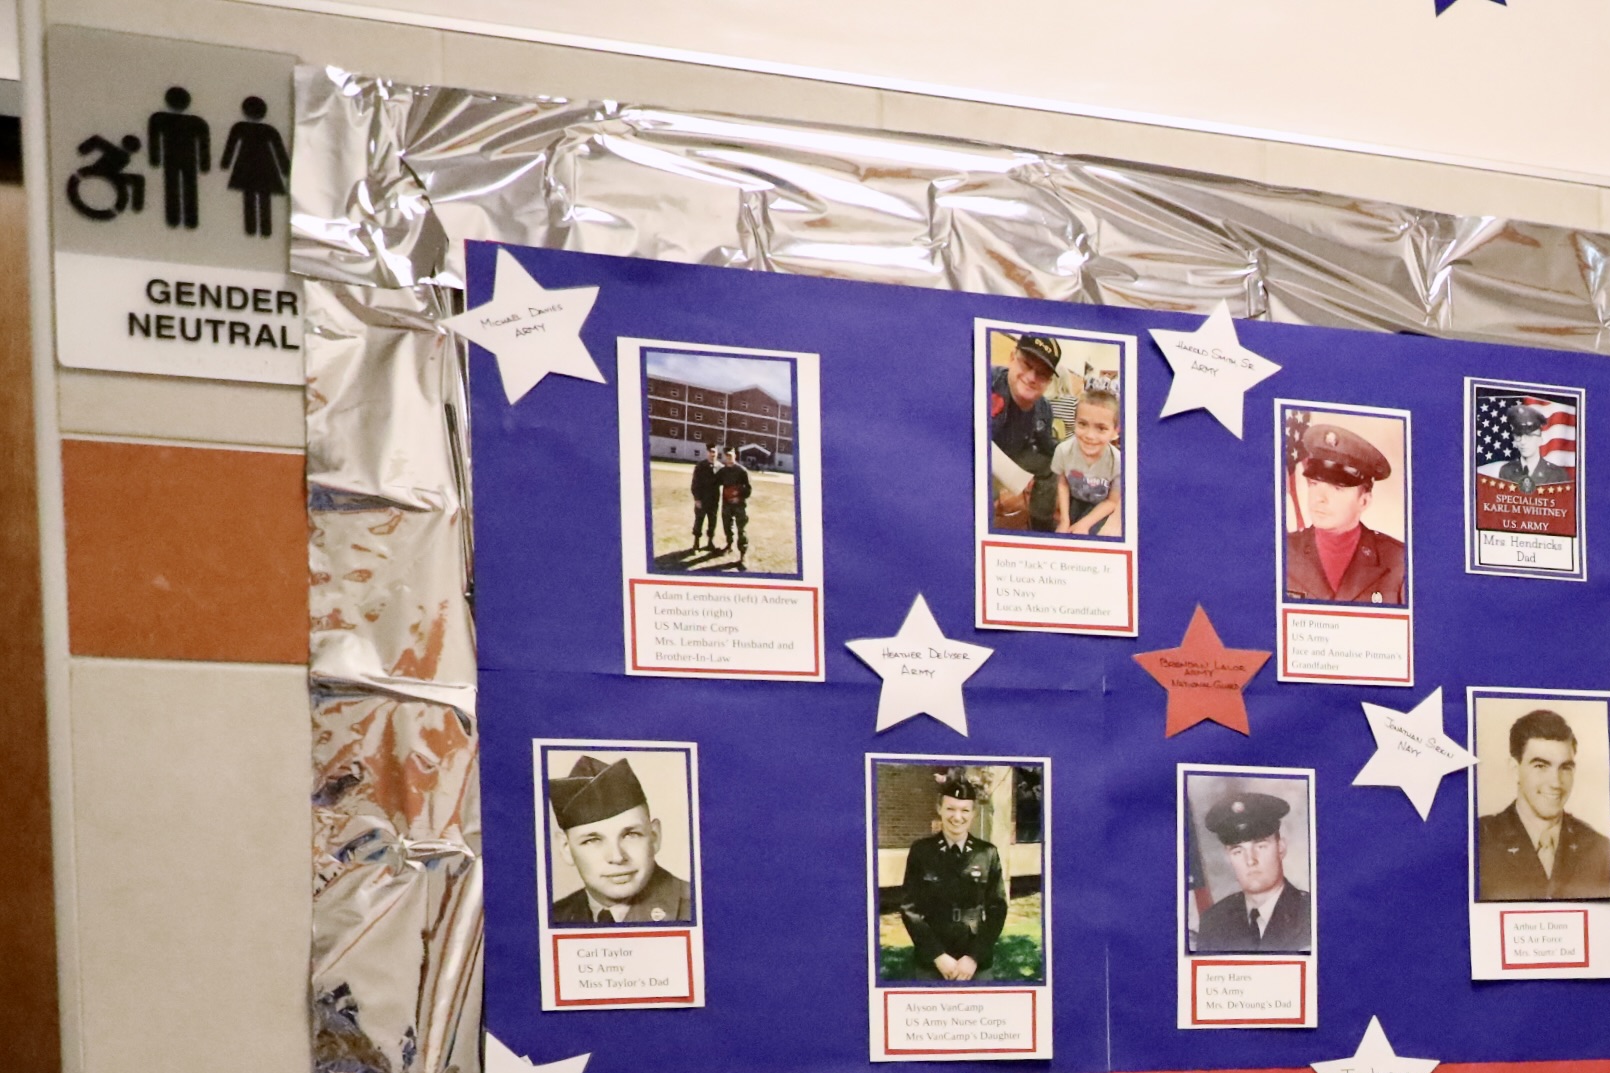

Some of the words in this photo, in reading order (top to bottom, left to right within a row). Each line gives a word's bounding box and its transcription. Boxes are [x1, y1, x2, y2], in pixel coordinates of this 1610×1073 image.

[145, 278, 299, 317] GENDER
[127, 312, 300, 350] NEUTRAL
[515, 323, 546, 338] ARMY
[1191, 361, 1219, 377] ARMY
[1496, 494, 1549, 507] SPECIALIST
[1550, 499, 1555, 507] 5
[1484, 503, 1510, 514] KARL
[1511, 505, 1522, 515] M
[1522, 506, 1568, 518] WHITNEY
[1503, 519, 1519, 530] U.S.
[1521, 521, 1550, 531] ARMY
[1511, 536, 1562, 551] Hendricks
[1516, 551, 1536, 563] Dad
[996, 558, 1017, 568] John
[1050, 561, 1058, 570] C
[1009, 574, 1035, 584] Lucas
[1038, 575, 1067, 586] Atkins
[654, 590, 683, 601] Adam
[686, 592, 730, 603] Lembaris
[734, 594, 758, 605] (left)
[761, 595, 798, 606] Andrew
[996, 587, 1010, 598] US
[1012, 588, 1036, 600] Navy
[654, 606, 698, 616] Lembaris
[702, 608, 733, 619] (right)
[996, 602, 1023, 612] Lucas
[1058, 605, 1112, 617] Grandfather
[654, 621, 669, 631] US
[673, 622, 707, 632] Marine
[710, 624, 739, 635] Corps
[1292, 619, 1306, 628] Jeff
[1309, 620, 1340, 630] Pittman
[655, 637, 675, 647] Mrs.
[733, 639, 774, 650] Husband
[778, 641, 794, 650] and
[1292, 633, 1304, 642] US
[1307, 634, 1329, 643] Army
[655, 652, 730, 664] Brother-In-Law
[882, 647, 922, 660] HEATHER
[1311, 648, 1325, 657] and
[901, 664, 935, 678] ARMY
[1292, 660, 1339, 671] Grandfather
[1398, 741, 1421, 758] NAVY
[1513, 936, 1525, 944] US
[577, 948, 598, 958] Carl
[602, 948, 633, 960] Taylor
[578, 964, 593, 974] US
[597, 964, 625, 976] Army
[579, 979, 603, 989] Miss
[605, 978, 646, 990] Taylor's
[649, 977, 670, 987] Dad
[1206, 987, 1219, 996] US
[1222, 987, 1244, 998] Army
[905, 1002, 938, 1014] Alyson
[1275, 1000, 1292, 1009] Dad
[905, 1017, 919, 1028] US
[922, 1018, 948, 1029] Army
[951, 1017, 977, 1027] Nurse
[979, 1016, 1007, 1028] Corps
[980, 1030, 1022, 1042] Daughter
